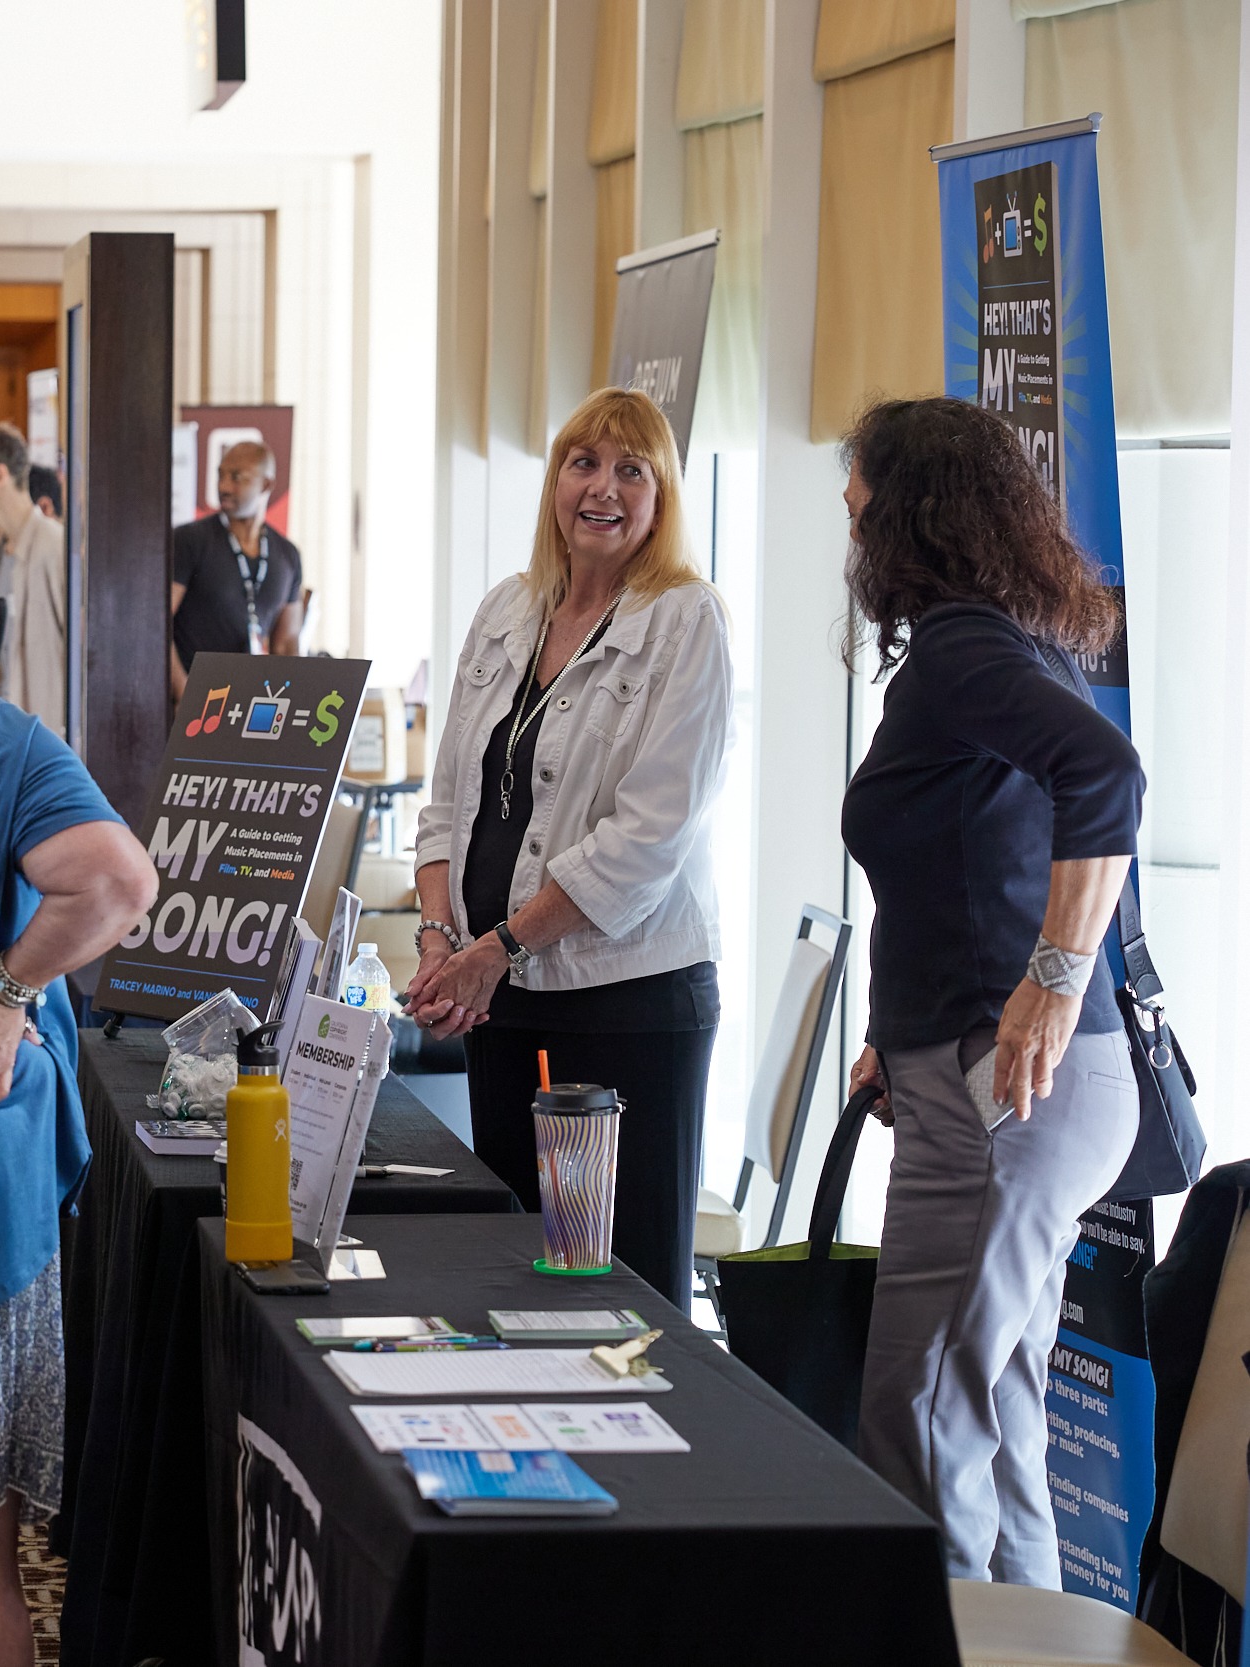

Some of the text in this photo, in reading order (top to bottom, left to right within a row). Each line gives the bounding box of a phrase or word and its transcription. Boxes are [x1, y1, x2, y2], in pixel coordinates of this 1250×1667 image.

[984, 299, 1052, 336] HEY! THAT'S
[981, 348, 1016, 412] MY
[162, 773, 322, 817] HEY! THAT'S
[147, 816, 229, 882] MY
[230, 828, 303, 845] A Guide to Getting
[224, 845, 303, 863] Music Placements in
[218, 863, 295, 880] Film, TV, and Media
[109, 978, 142, 992] TRACEY
[142, 984, 177, 997] MARINO
[177, 989, 192, 999] and
[297, 1041, 355, 1071] MEMBERSHIP
[1110, 1202, 1136, 1226] Industry
[1100, 1224, 1107, 1242] be
[1108, 1227, 1121, 1246] able
[1122, 1232, 1129, 1249] to
[1054, 1346, 1109, 1389] MY SONG!
[1055, 1378, 1080, 1403] three
[1082, 1393, 1108, 1416] parts:
[1059, 1436, 1084, 1458] music
[1074, 1424, 1120, 1459] producing,
[1049, 1471, 1129, 1523] Finding companies
[1055, 1494, 1080, 1517] music
[1065, 1558, 1095, 1586] money
[1096, 1572, 1110, 1592] for
[1112, 1583, 1130, 1602] you
[1102, 1556, 1122, 1579] how
